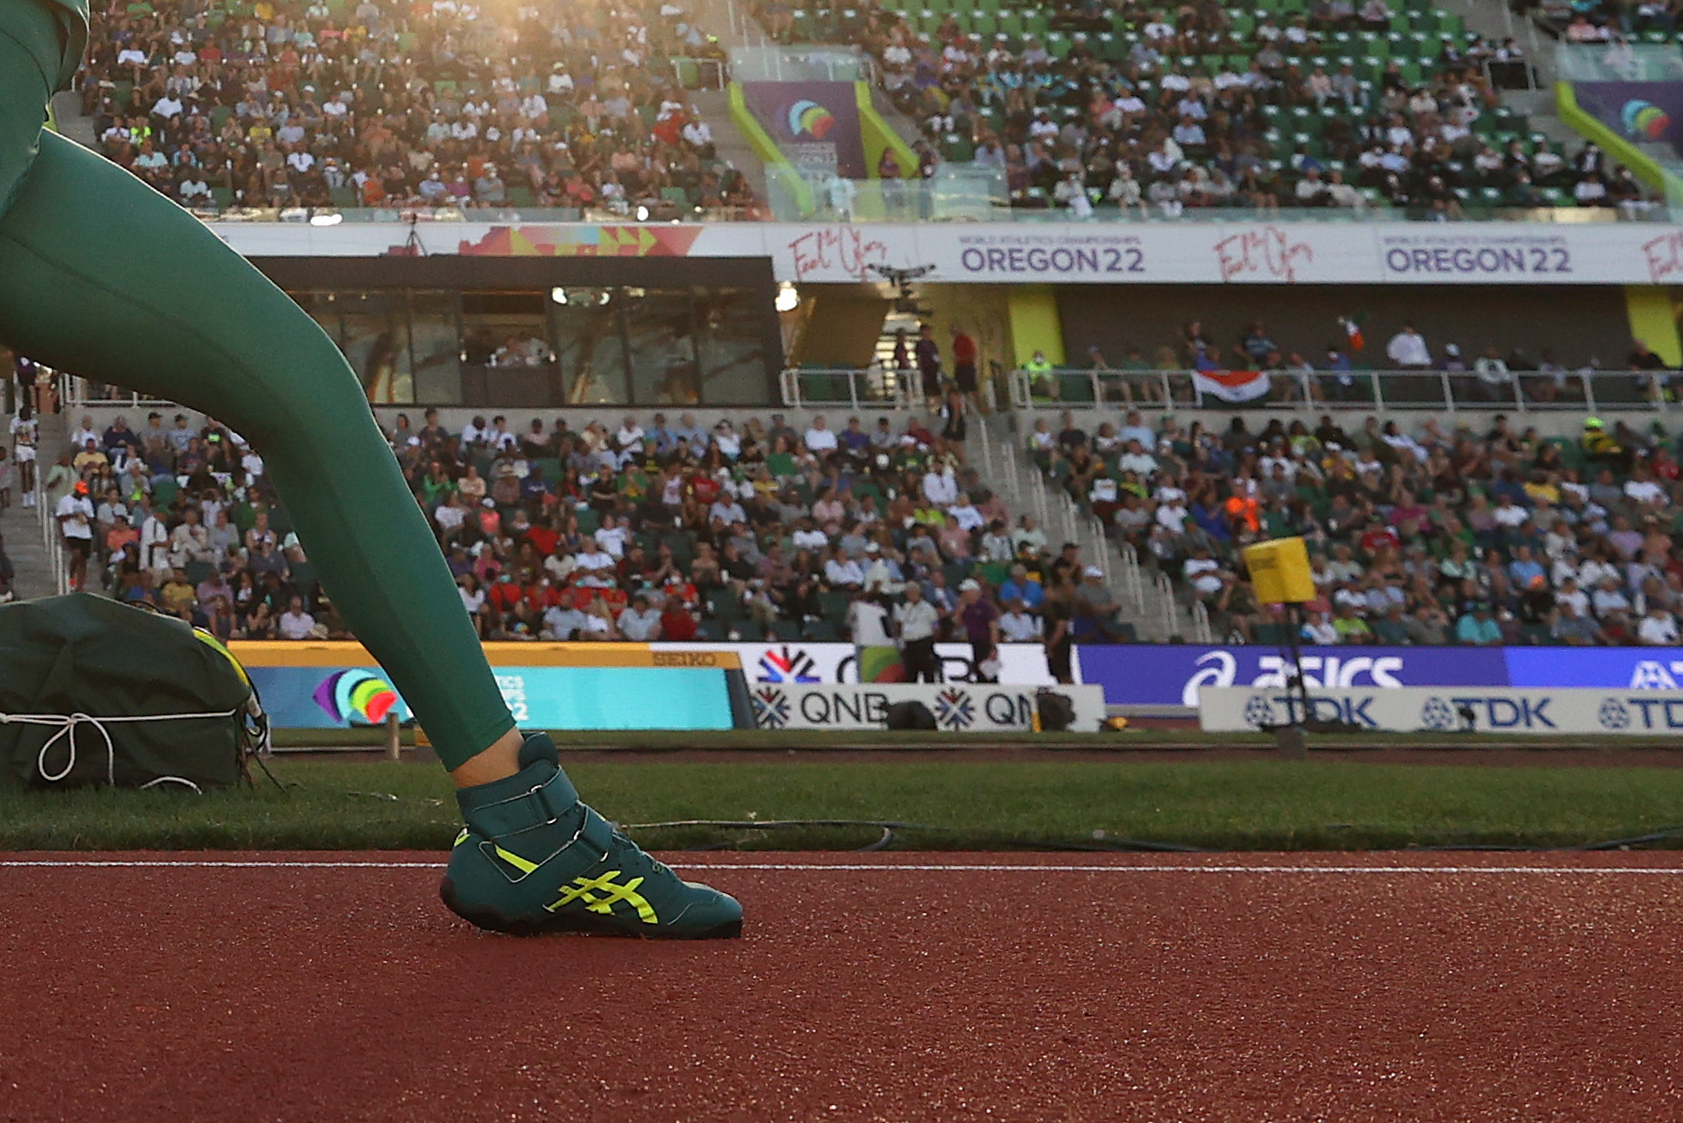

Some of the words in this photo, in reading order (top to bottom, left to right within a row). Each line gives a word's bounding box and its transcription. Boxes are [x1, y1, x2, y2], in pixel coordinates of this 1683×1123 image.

[962, 248, 1146, 272] OREGON22
[1387, 248, 1573, 273] OREGON22
[800, 692, 889, 724] QNB
[1273, 696, 1377, 727] TDK
[1451, 697, 1556, 729] TDK
